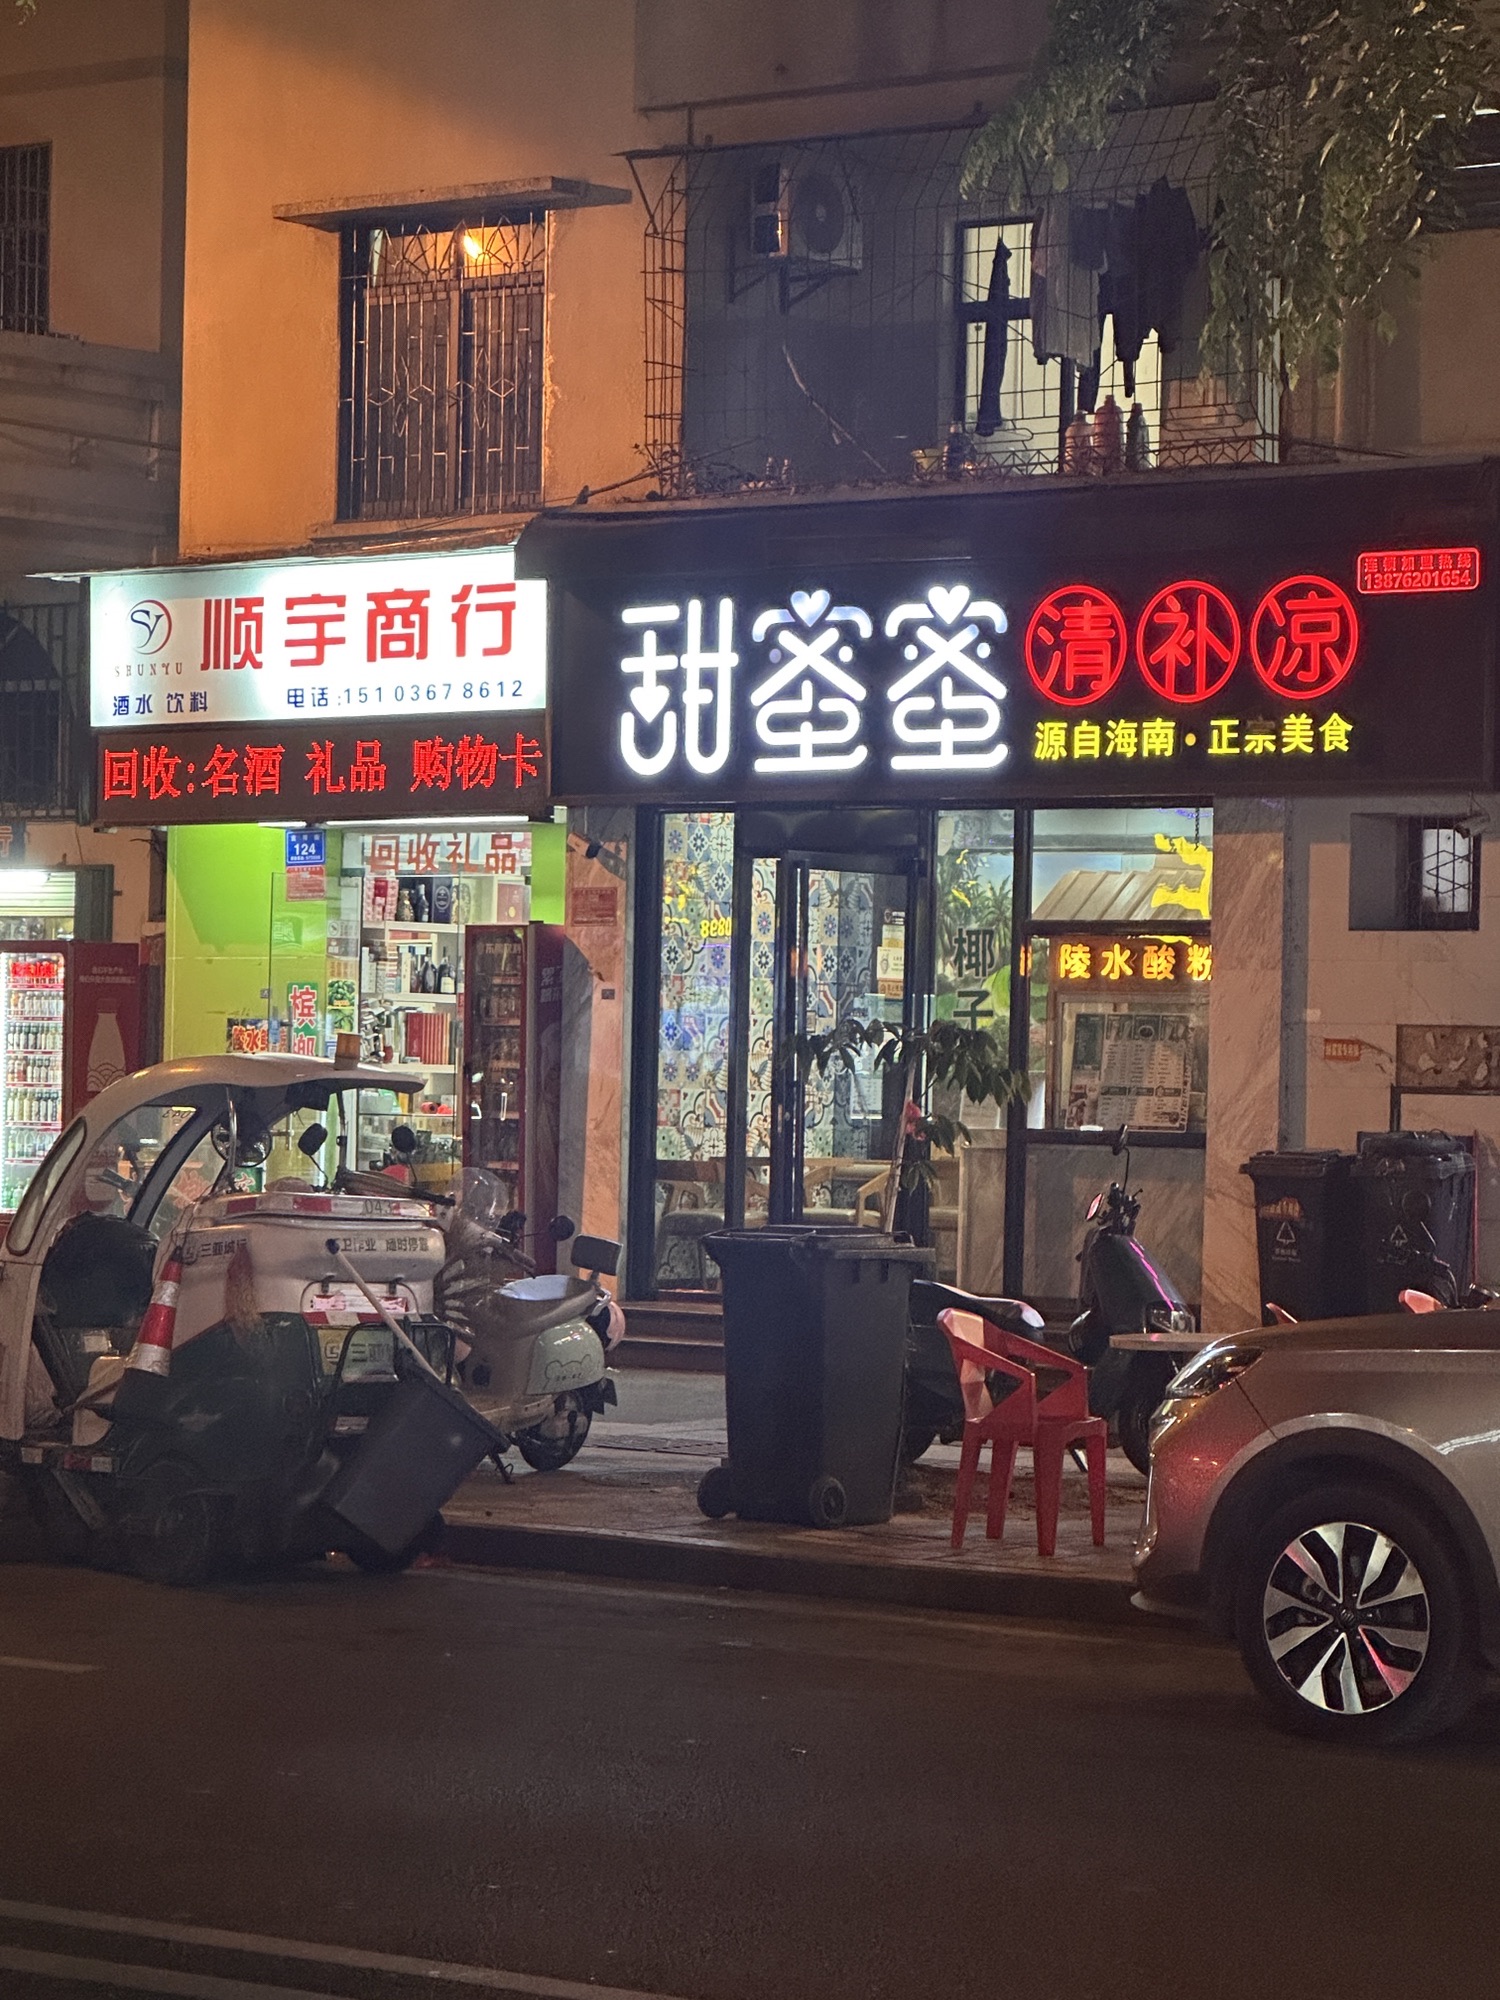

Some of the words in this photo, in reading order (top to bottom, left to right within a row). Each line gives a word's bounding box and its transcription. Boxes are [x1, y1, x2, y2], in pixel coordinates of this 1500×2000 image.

[1365, 553, 1472, 573] 连锁加盟热线
[1365, 569, 1472, 589] 13876201654
[200, 582, 517, 671] 顺宇商行
[1033, 588, 1346, 695] 清补凉
[620, 584, 1009, 776] 甜蜜蜜
[113, 694, 153, 716] 酒水
[166, 691, 208, 713] 饮料
[103, 744, 286, 801] 回收:名酒
[305, 739, 387, 794] 礼品
[410, 732, 543, 791] 购物卡
[294, 843, 316, 856] 124
[369, 833, 517, 874] 回收礼品
[952, 927, 996, 1029] 椰子
[1059, 943, 1213, 982] 陵水酸粉
